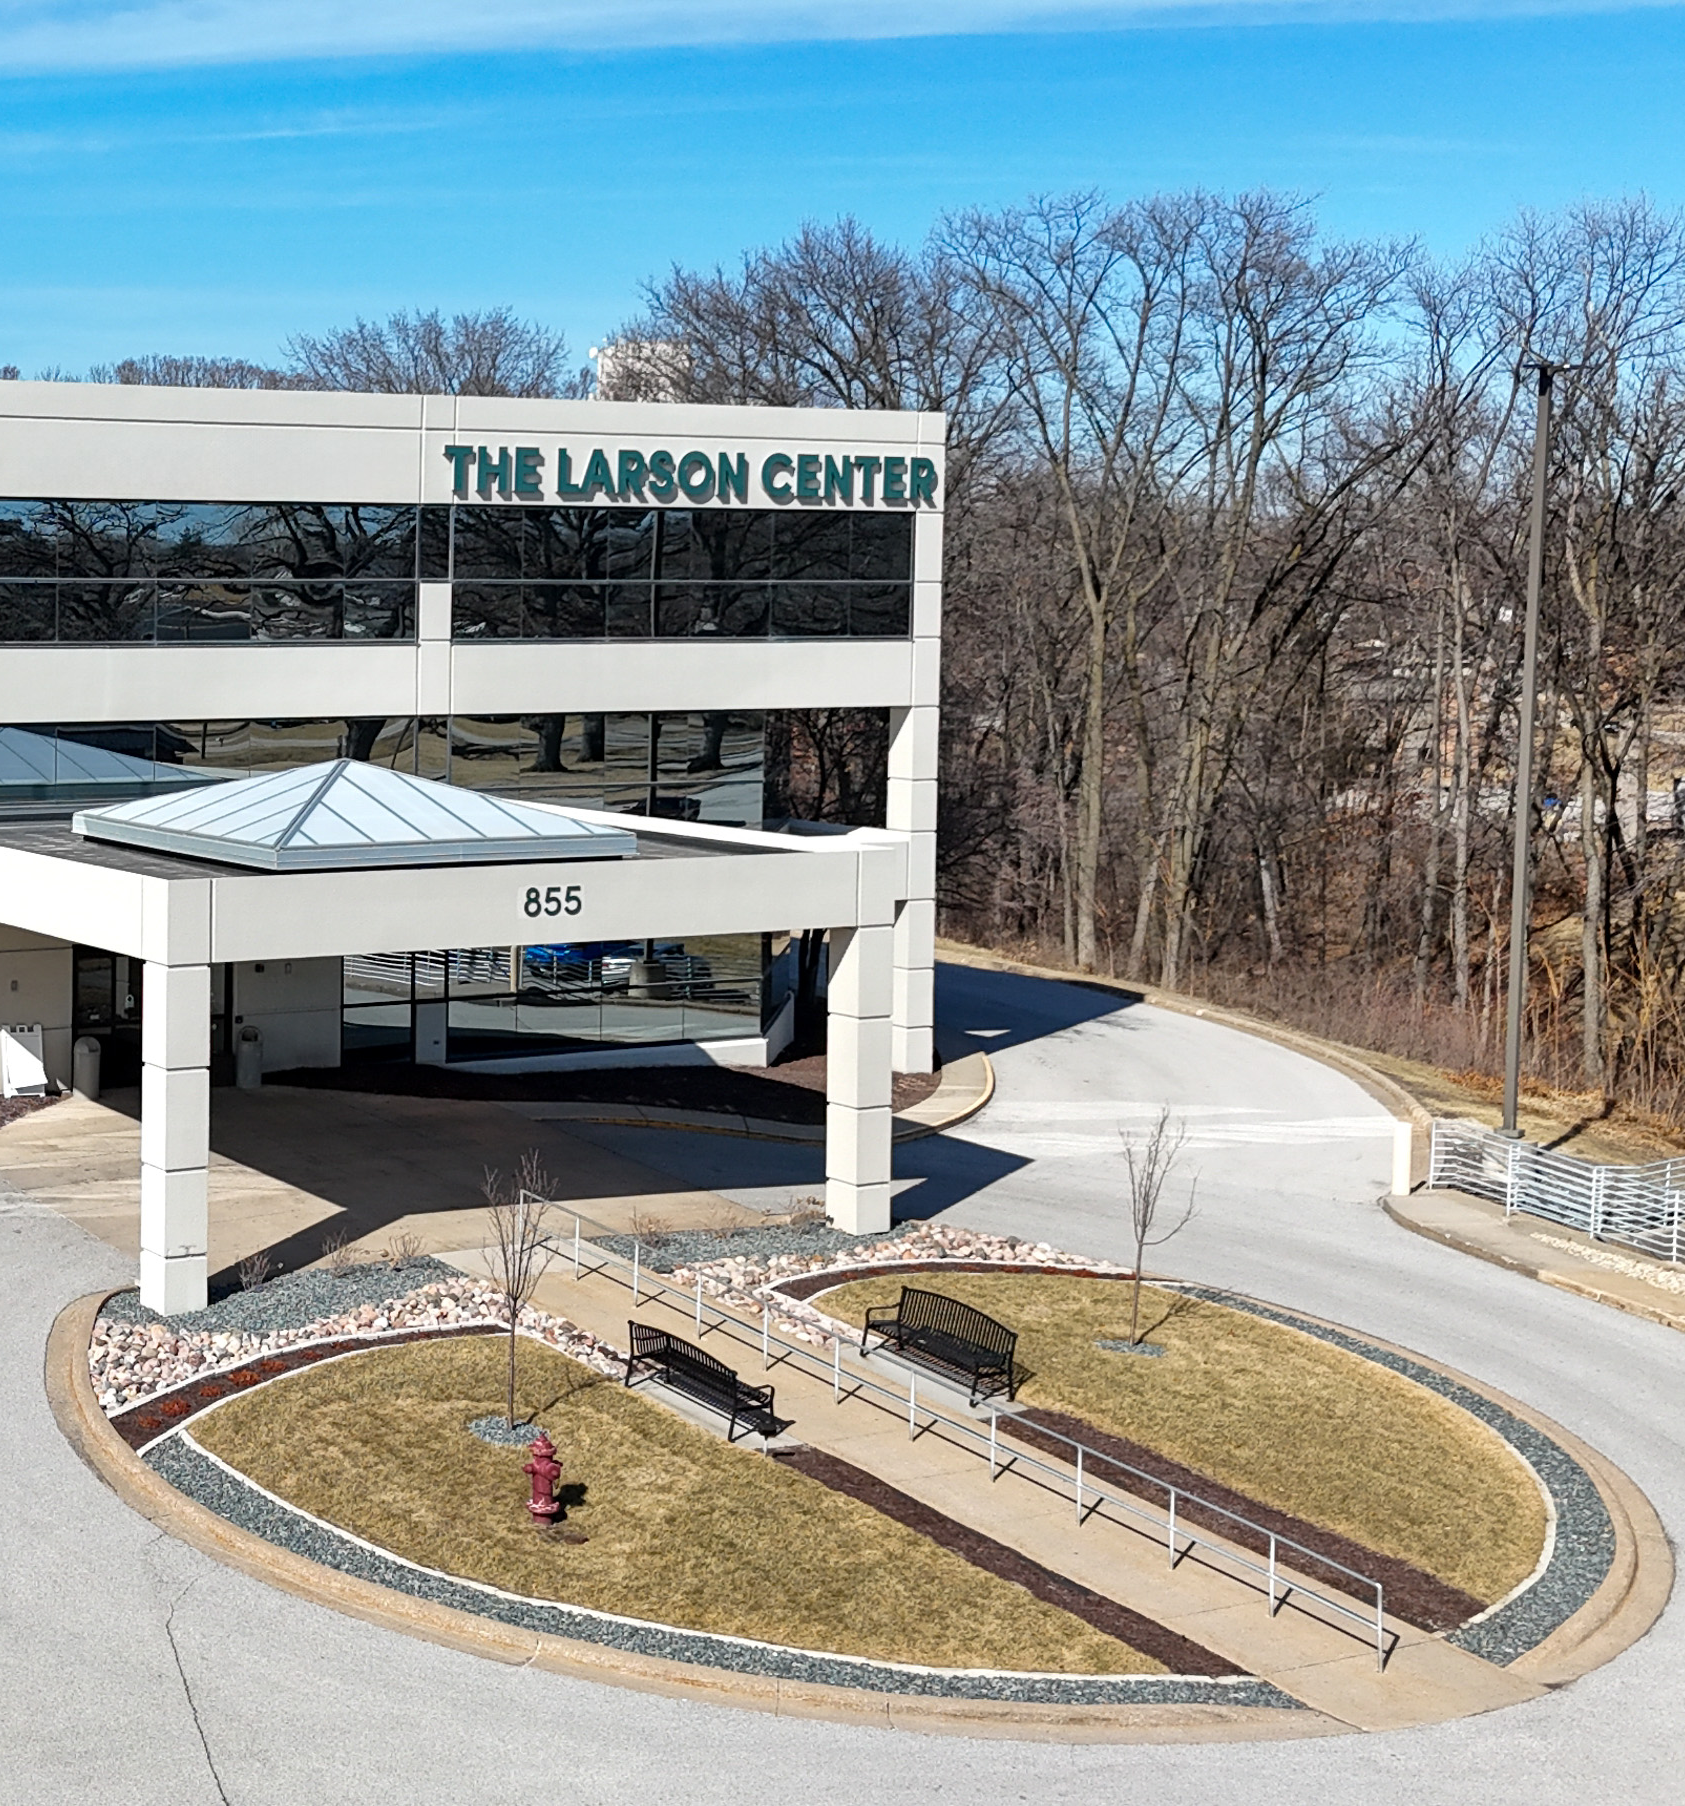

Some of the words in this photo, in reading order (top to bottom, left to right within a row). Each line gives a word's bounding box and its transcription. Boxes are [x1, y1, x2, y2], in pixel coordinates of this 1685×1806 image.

[444, 445, 540, 494] THE
[557, 448, 747, 496] LARSON
[761, 452, 936, 500] CENTER
[524, 885, 582, 917] 855
